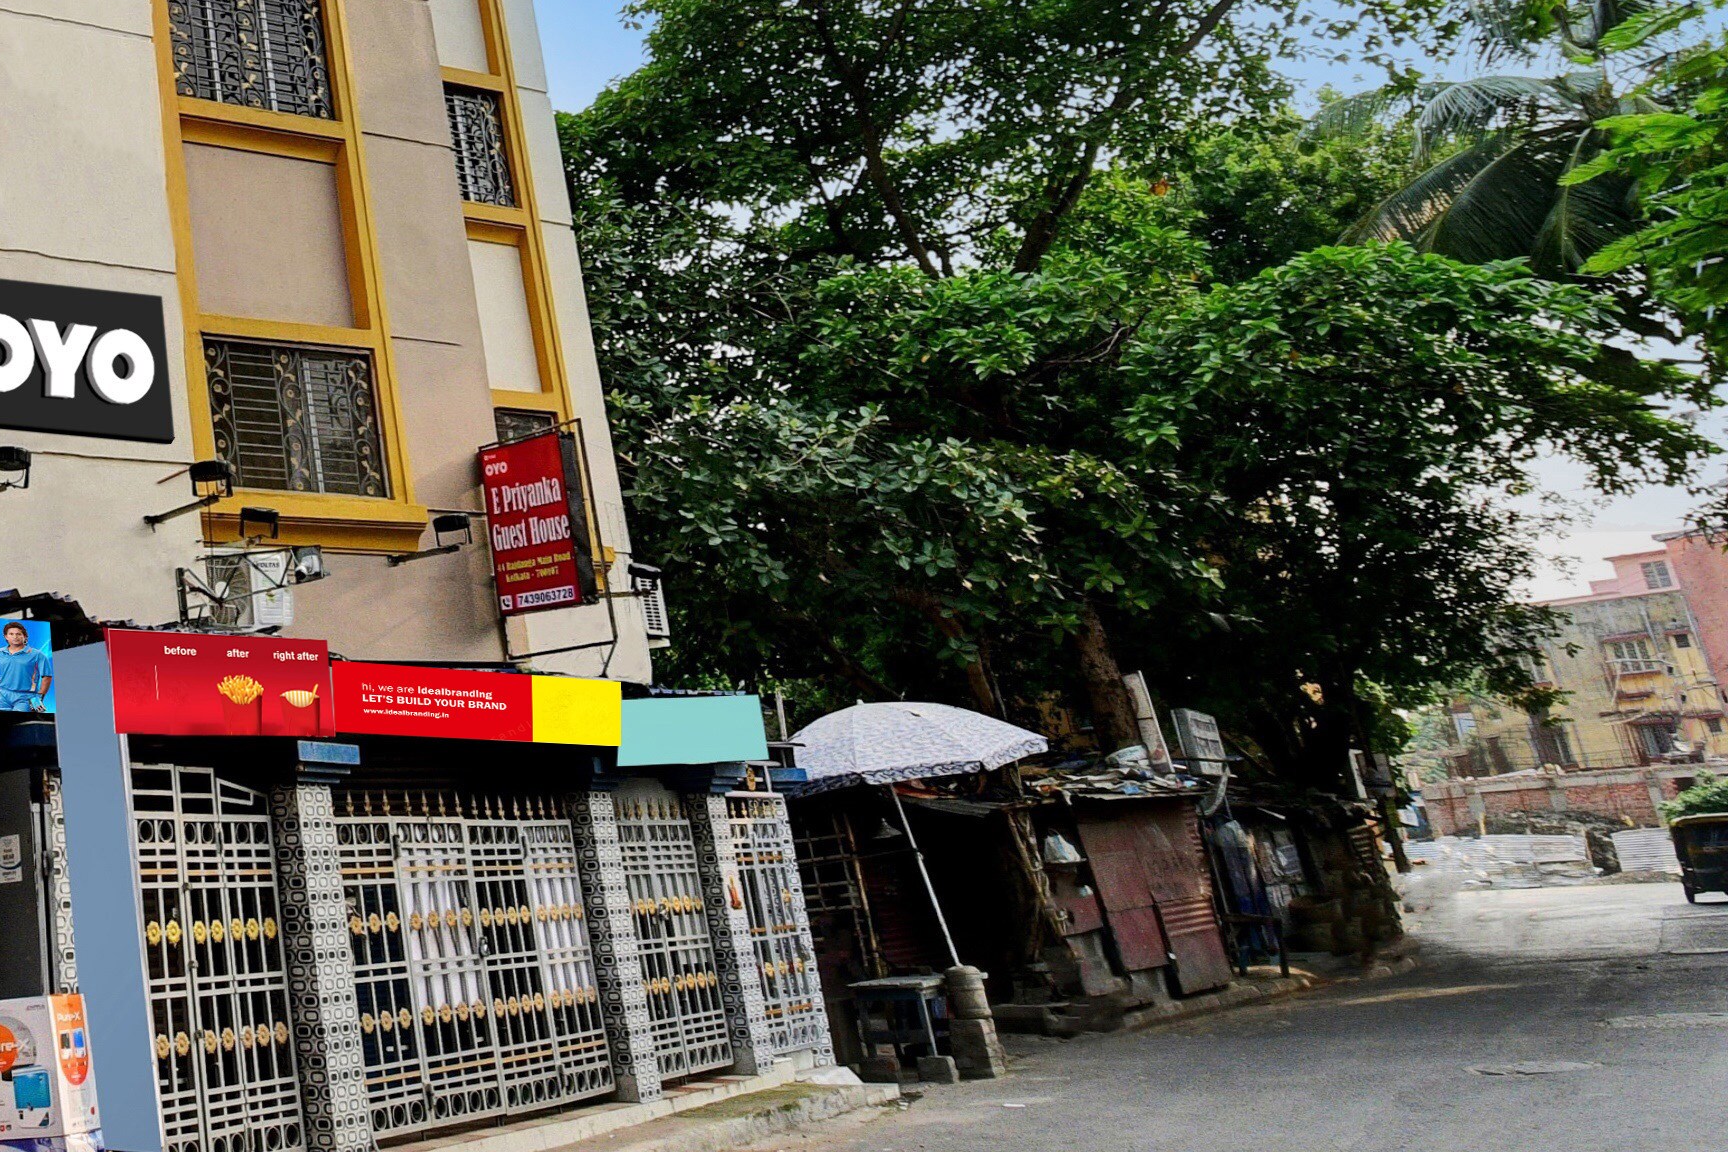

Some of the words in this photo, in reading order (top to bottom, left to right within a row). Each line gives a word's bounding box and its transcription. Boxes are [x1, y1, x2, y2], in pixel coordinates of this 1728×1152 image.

[485, 461, 508, 476] OYO
[491, 487, 501, 514] E
[501, 476, 562, 513] Priyanka
[493, 519, 528, 551] Guest
[529, 514, 571, 545] House
[518, 588, 574, 605] 7439063728
[164, 646, 197, 656] before
[227, 649, 250, 658] after
[273, 651, 295, 662] right
[297, 652, 319, 661] after
[361, 683, 375, 692] hi,
[397, 686, 414, 694] are
[362, 694, 393, 704] LET'S
[397, 696, 431, 706] BUILD
[434, 698, 465, 708] YOUR
[468, 700, 507, 711] BRAND
